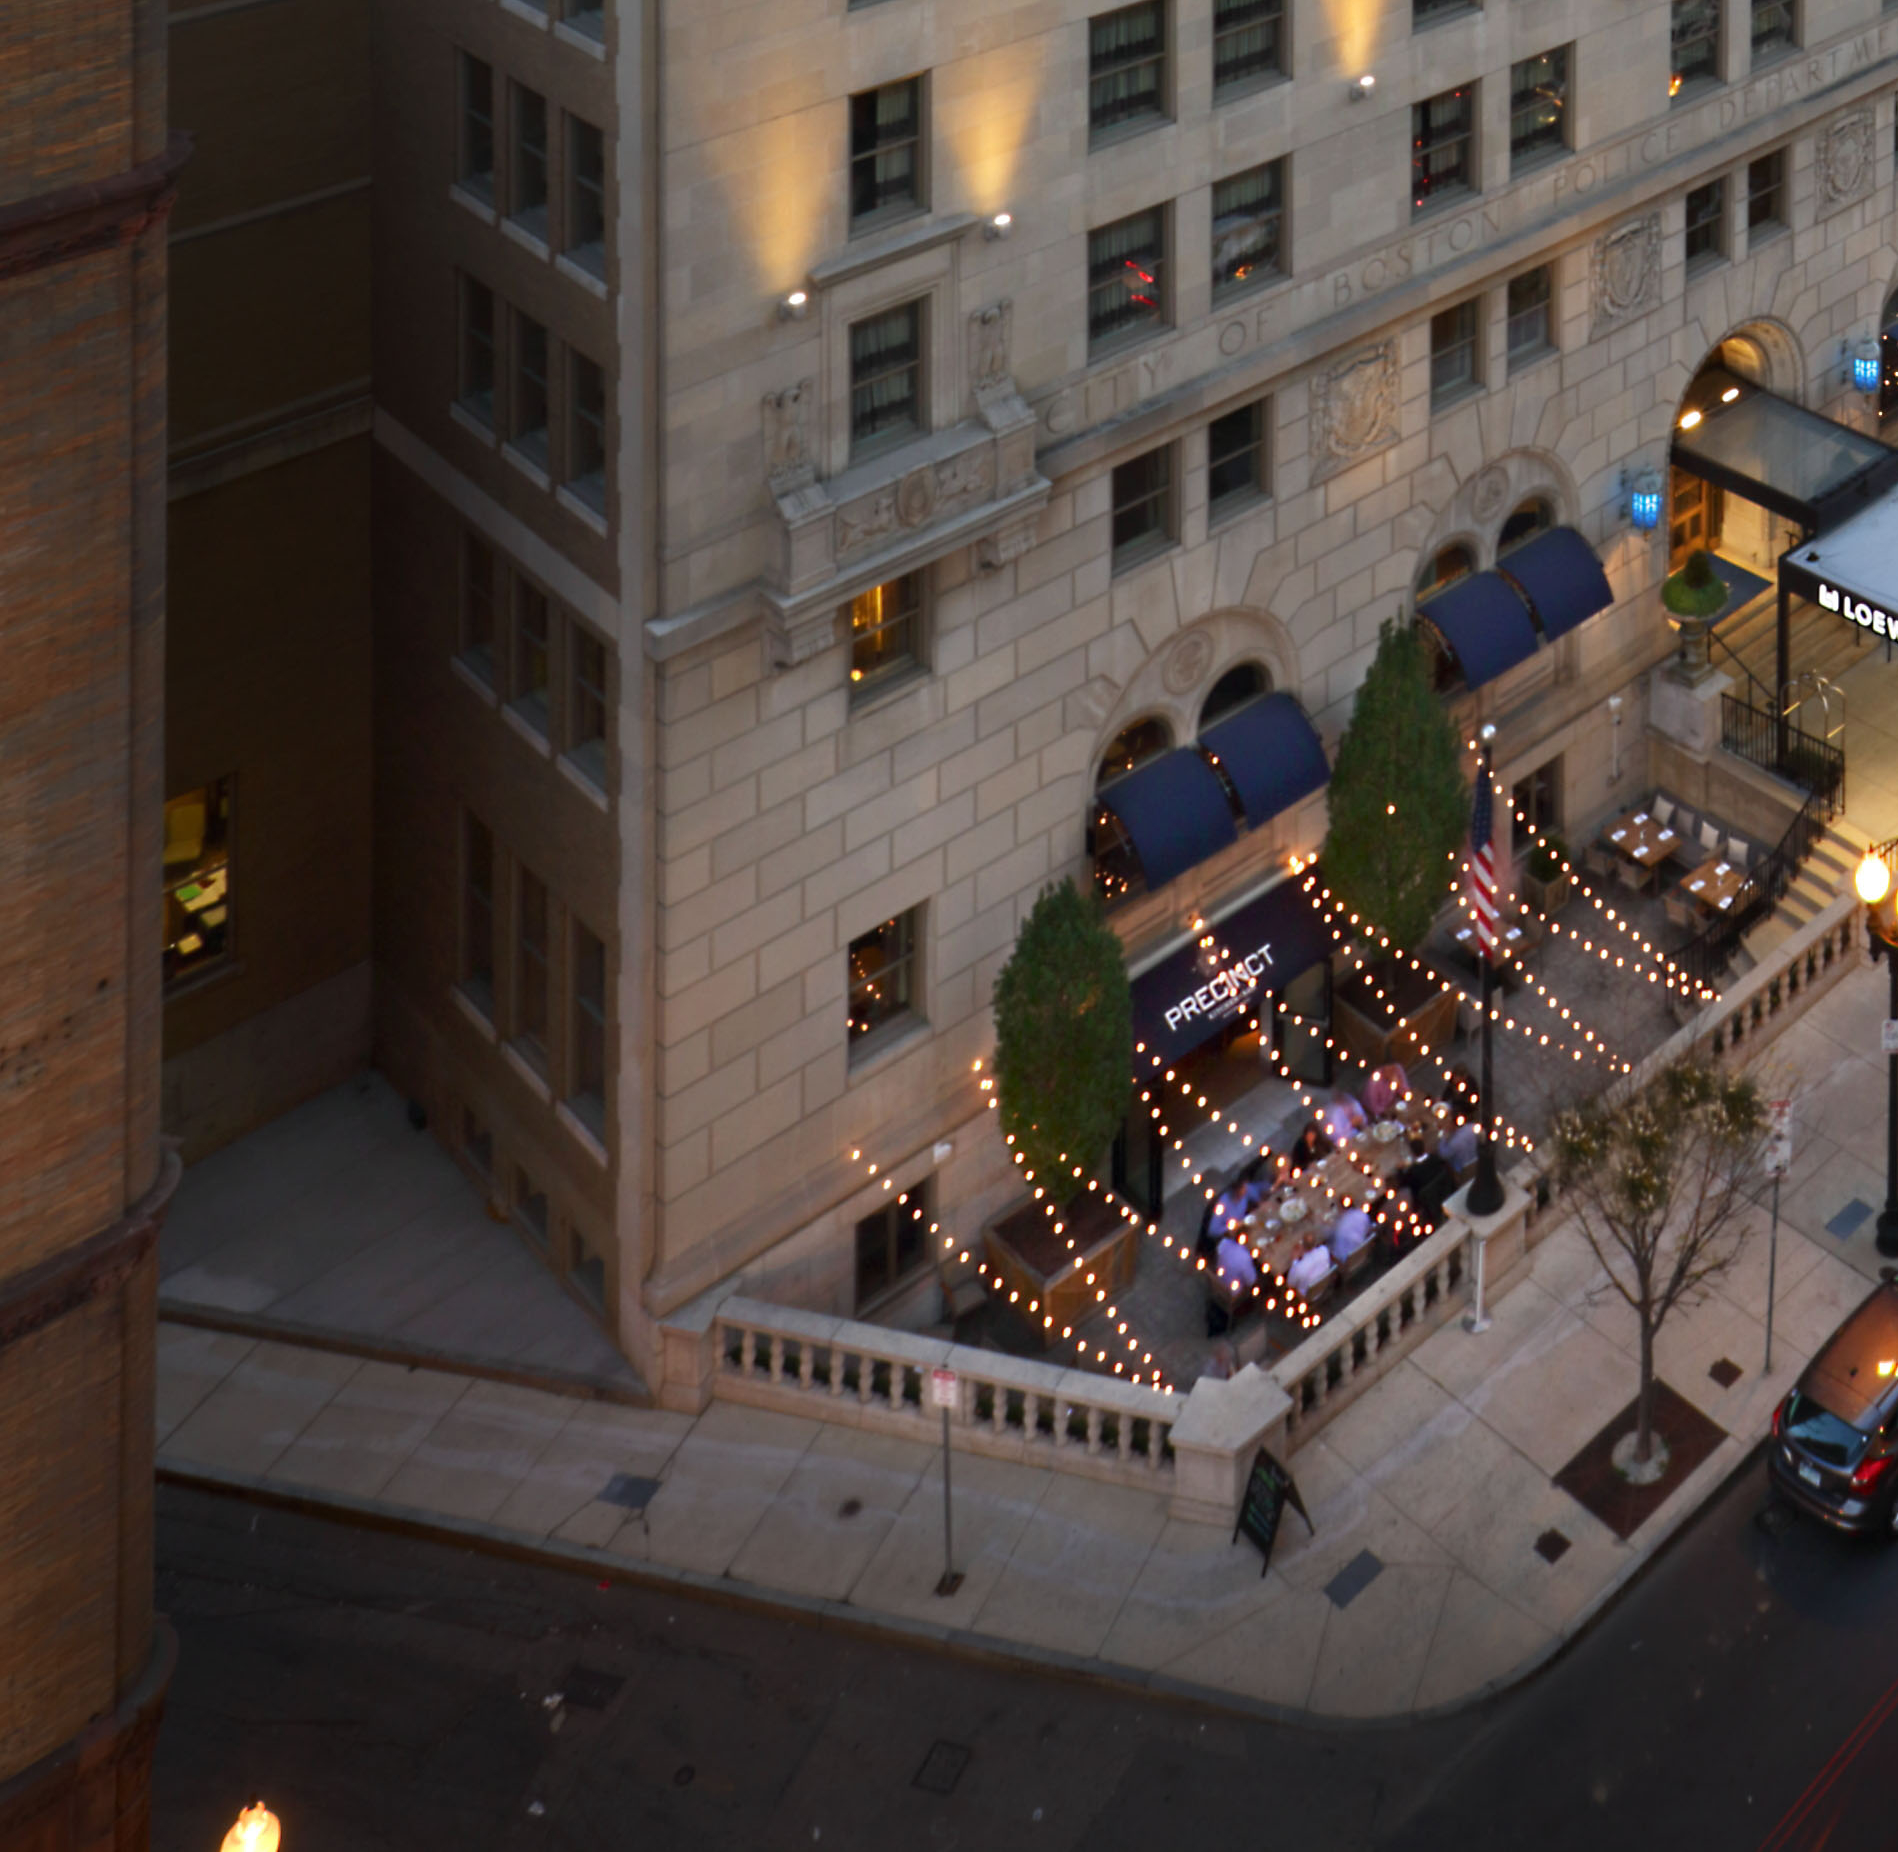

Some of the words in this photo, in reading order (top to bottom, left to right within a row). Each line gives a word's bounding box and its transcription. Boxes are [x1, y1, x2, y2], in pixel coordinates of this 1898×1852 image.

[1045, 352, 1166, 434] CITY
[1218, 305, 1273, 356] OF
[1333, 203, 1504, 307] BOSTON
[1553, 121, 1682, 206] POLICE
[1164, 943, 1273, 1031] PRECINCT
